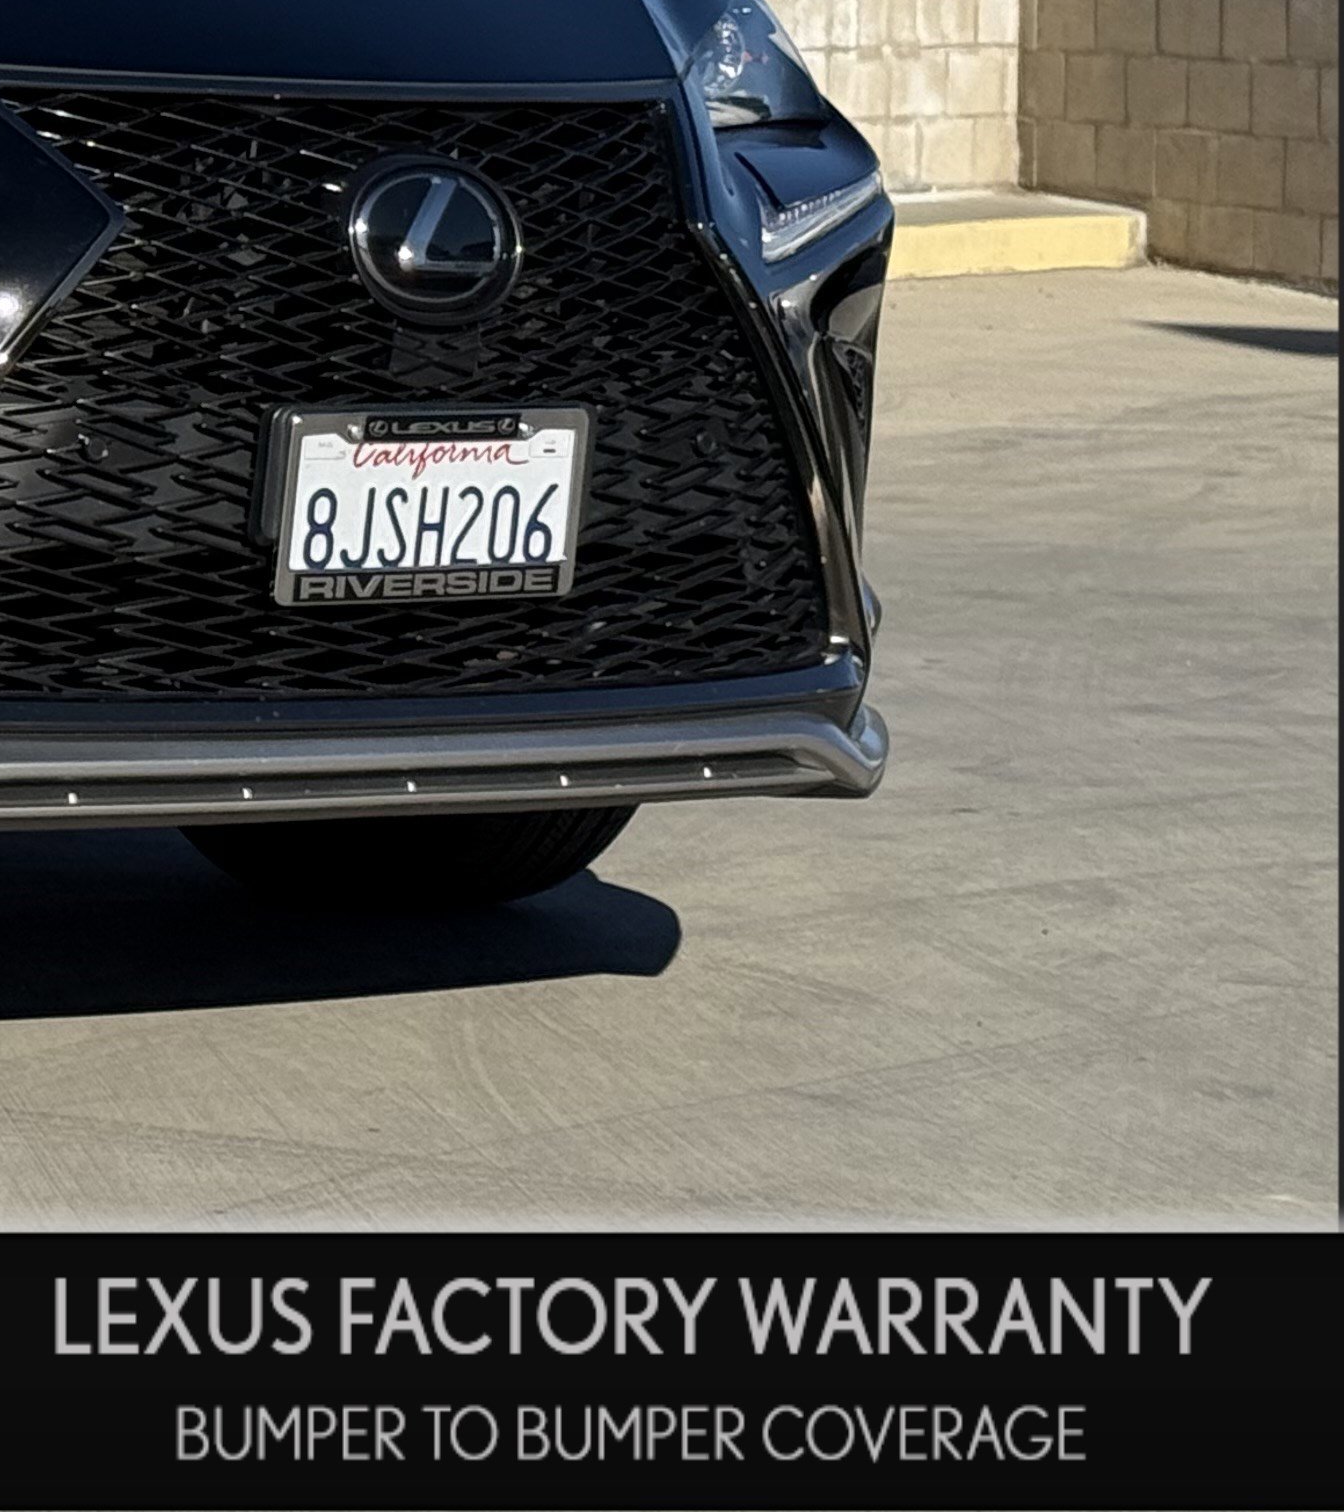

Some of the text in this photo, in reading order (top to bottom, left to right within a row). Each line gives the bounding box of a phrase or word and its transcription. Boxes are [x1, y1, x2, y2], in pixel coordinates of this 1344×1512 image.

[391, 419, 496, 435] LEXUS
[352, 440, 529, 480] California
[302, 483, 559, 571] 8JSH206
[298, 568, 555, 600] RIVERSIDE
